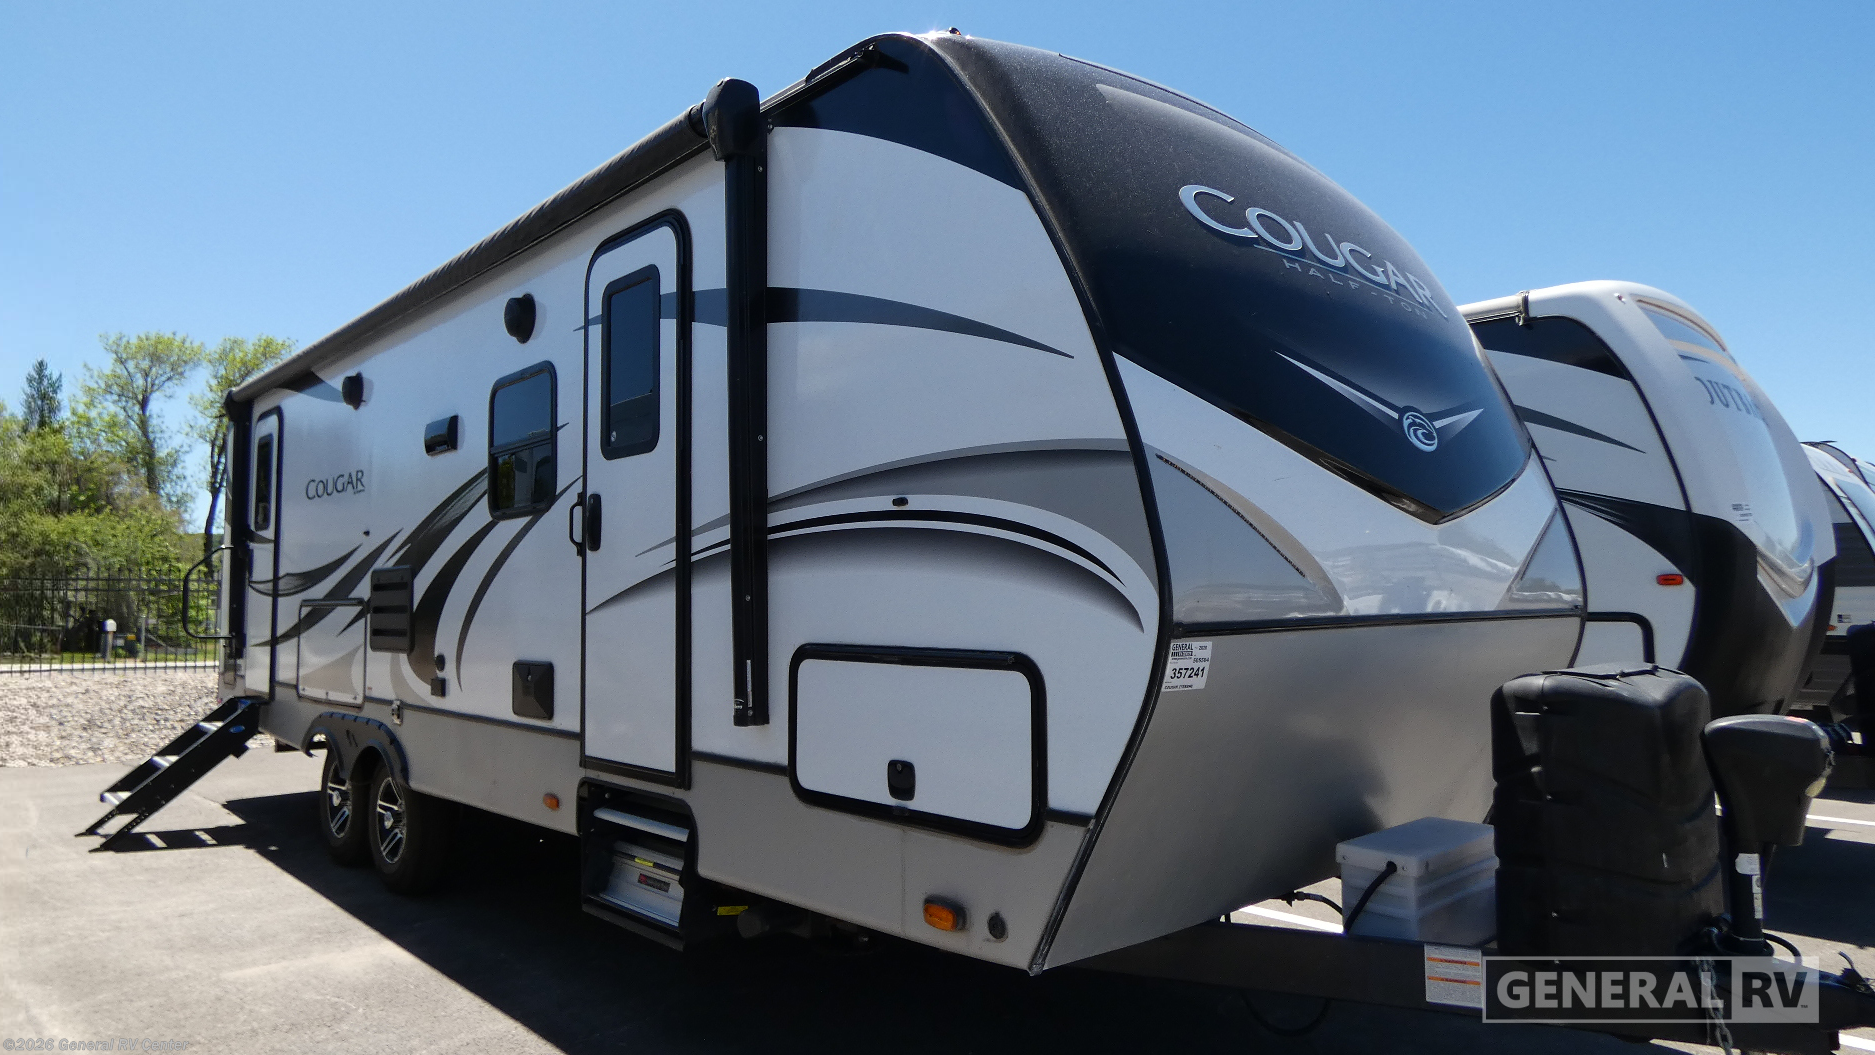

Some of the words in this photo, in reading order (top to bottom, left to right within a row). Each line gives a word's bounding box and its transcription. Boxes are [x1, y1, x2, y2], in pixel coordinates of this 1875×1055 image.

[1179, 184, 1448, 319] COUGAR
[305, 469, 365, 500] COUGAR
[1171, 643, 1193, 651] GENERAL
[1170, 666, 1206, 680] 357241
